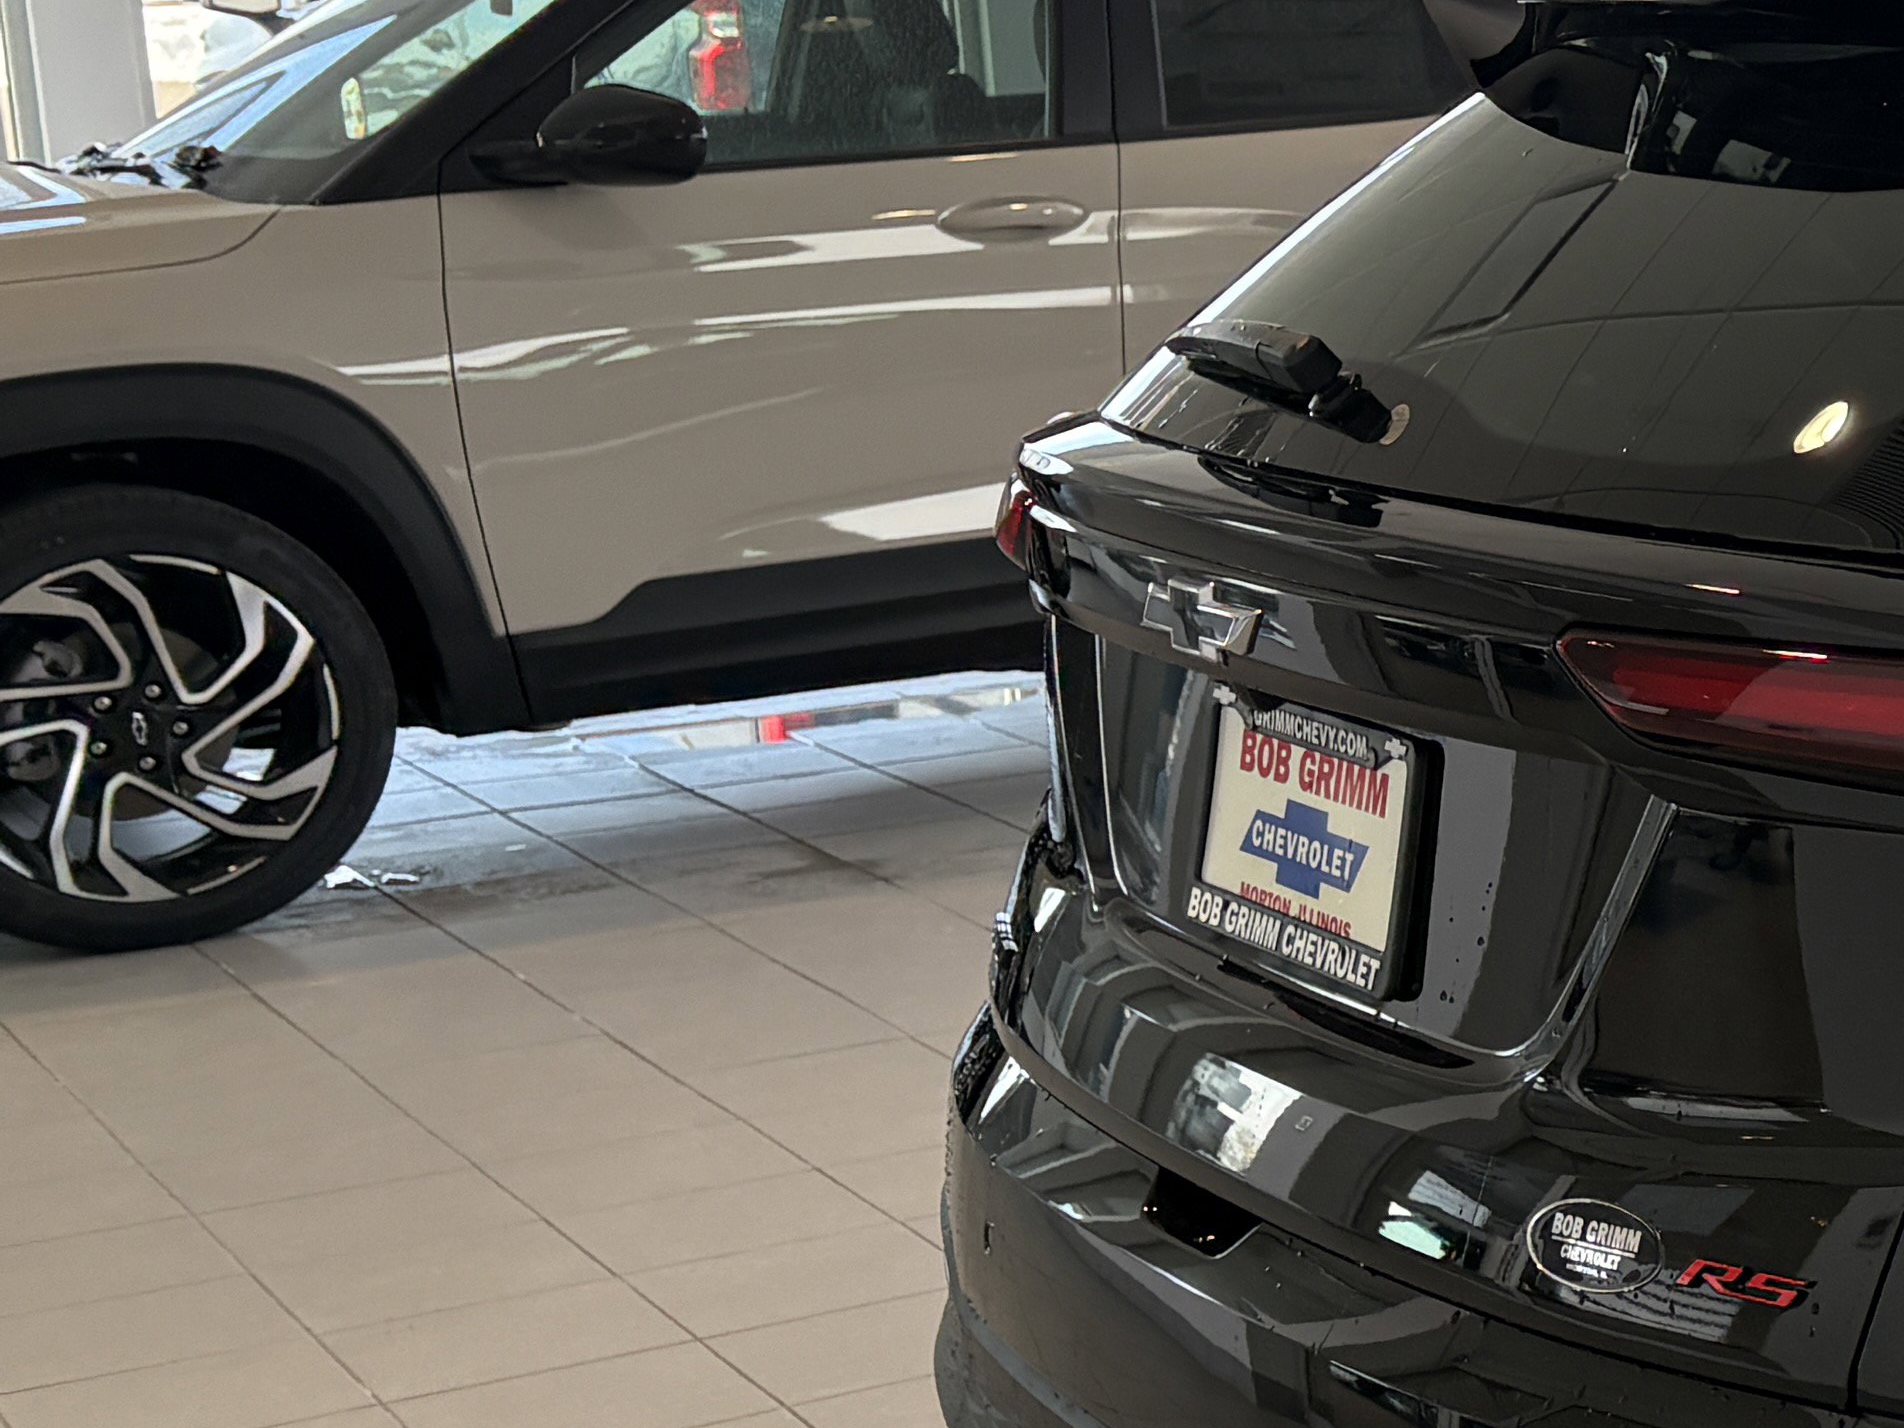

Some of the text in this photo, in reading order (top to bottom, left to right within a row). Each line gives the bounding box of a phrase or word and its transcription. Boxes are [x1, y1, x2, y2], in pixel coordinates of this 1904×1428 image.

[1253, 710, 1368, 759] GRIMMCHEVY.COM
[1240, 728, 1389, 819] BOB GRIMM
[1252, 820, 1355, 881] CHEVROLET
[1187, 887, 1381, 990] BOB GRIMM CHEVROLET
[1552, 1212, 1642, 1253] BOB GRIMM
[1560, 1244, 1621, 1270] CHEVROLET
[1676, 1259, 1808, 1308] RS
